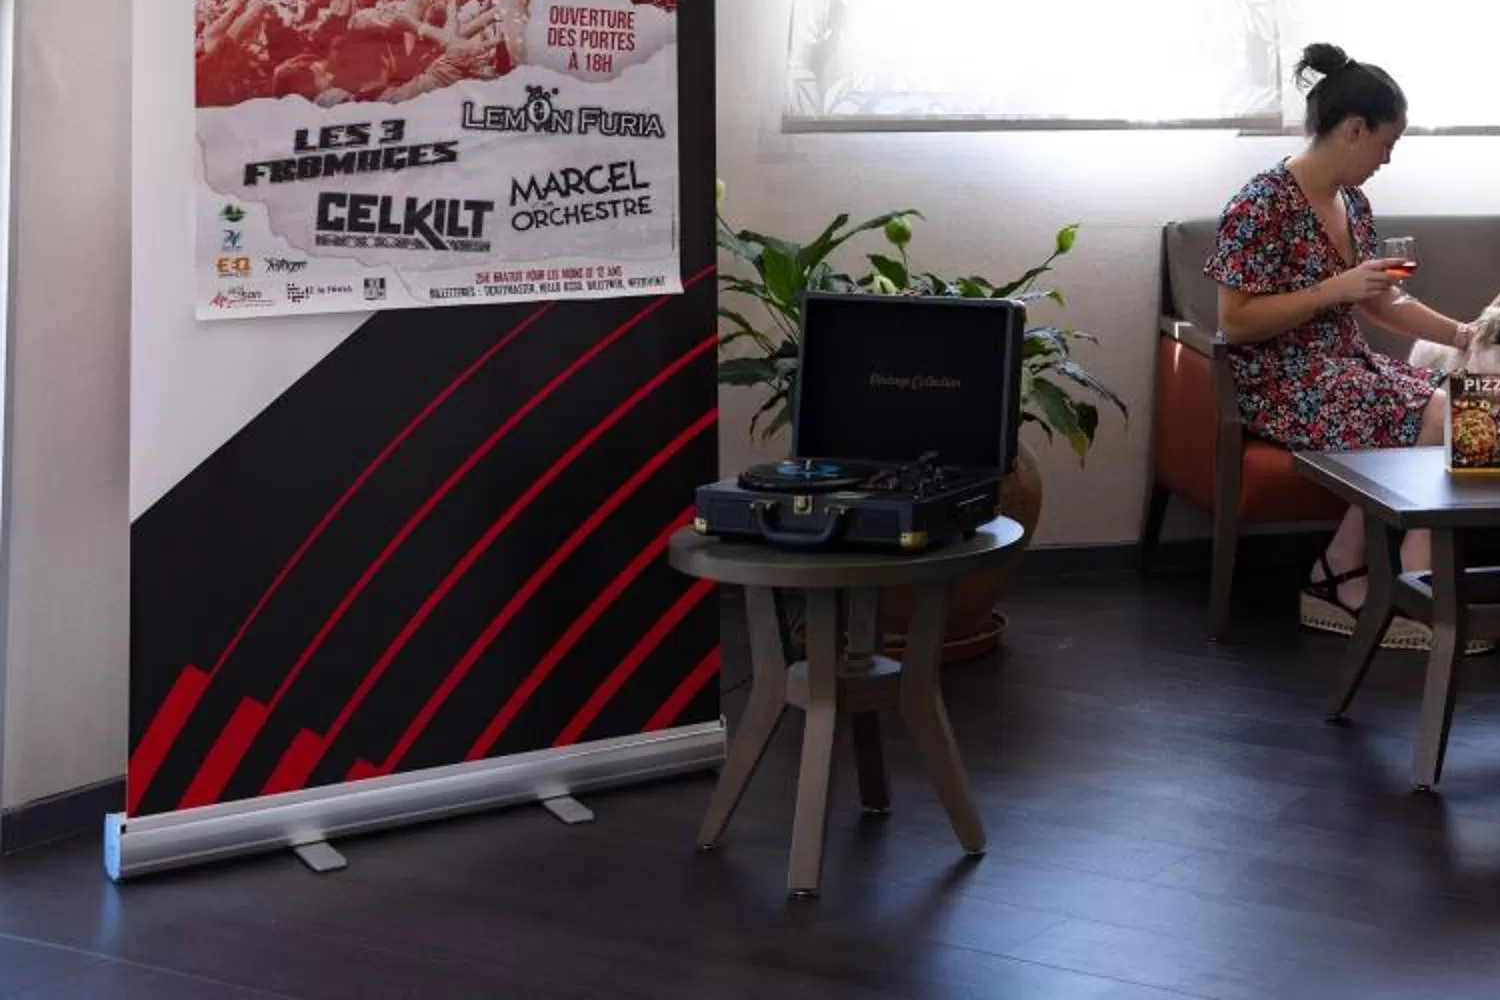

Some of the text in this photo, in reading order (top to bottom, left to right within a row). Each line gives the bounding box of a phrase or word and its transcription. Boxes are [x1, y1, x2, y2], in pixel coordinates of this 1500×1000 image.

[549, 5, 635, 29] OUVERTURE
[547, 28, 635, 51] DES PORTES
[582, 54, 613, 73] 18H
[294, 119, 405, 153] LES 3
[578, 108, 666, 138] FURIA
[243, 140, 458, 187] FROMAGES
[509, 160, 651, 206] MARCEL
[315, 191, 494, 250] CELKILT
[511, 196, 652, 231] ORCHESTRE
